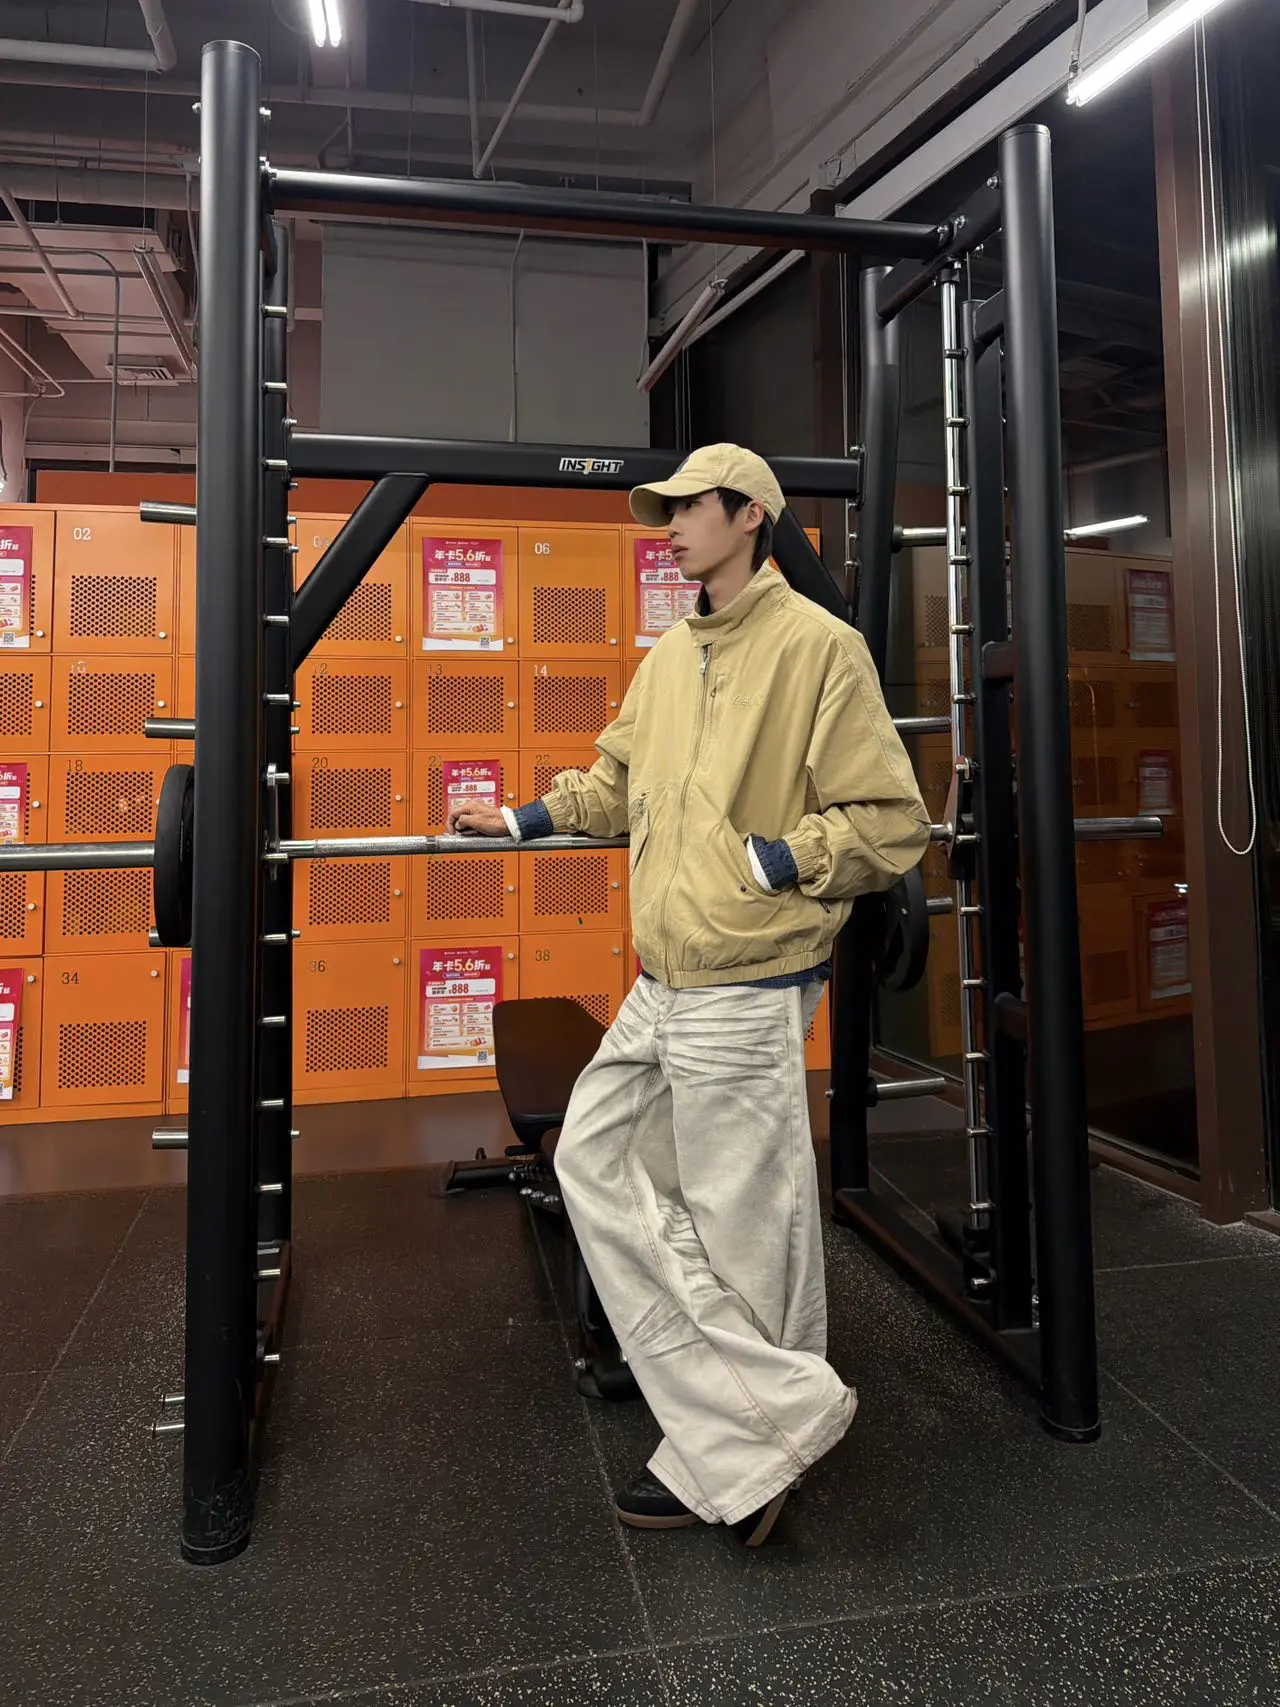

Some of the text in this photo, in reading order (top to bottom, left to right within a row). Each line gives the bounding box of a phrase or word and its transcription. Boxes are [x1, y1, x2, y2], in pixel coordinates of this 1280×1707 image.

[73, 527, 92, 541] 02
[534, 542, 550, 555] 06
[533, 664, 548, 676] 14
[67, 759, 83, 772] 18
[312, 756, 328, 769] 20
[535, 754, 551, 766] 22
[534, 950, 551, 962] 38
[310, 959, 327, 973] 36
[61, 971, 79, 985] 34
